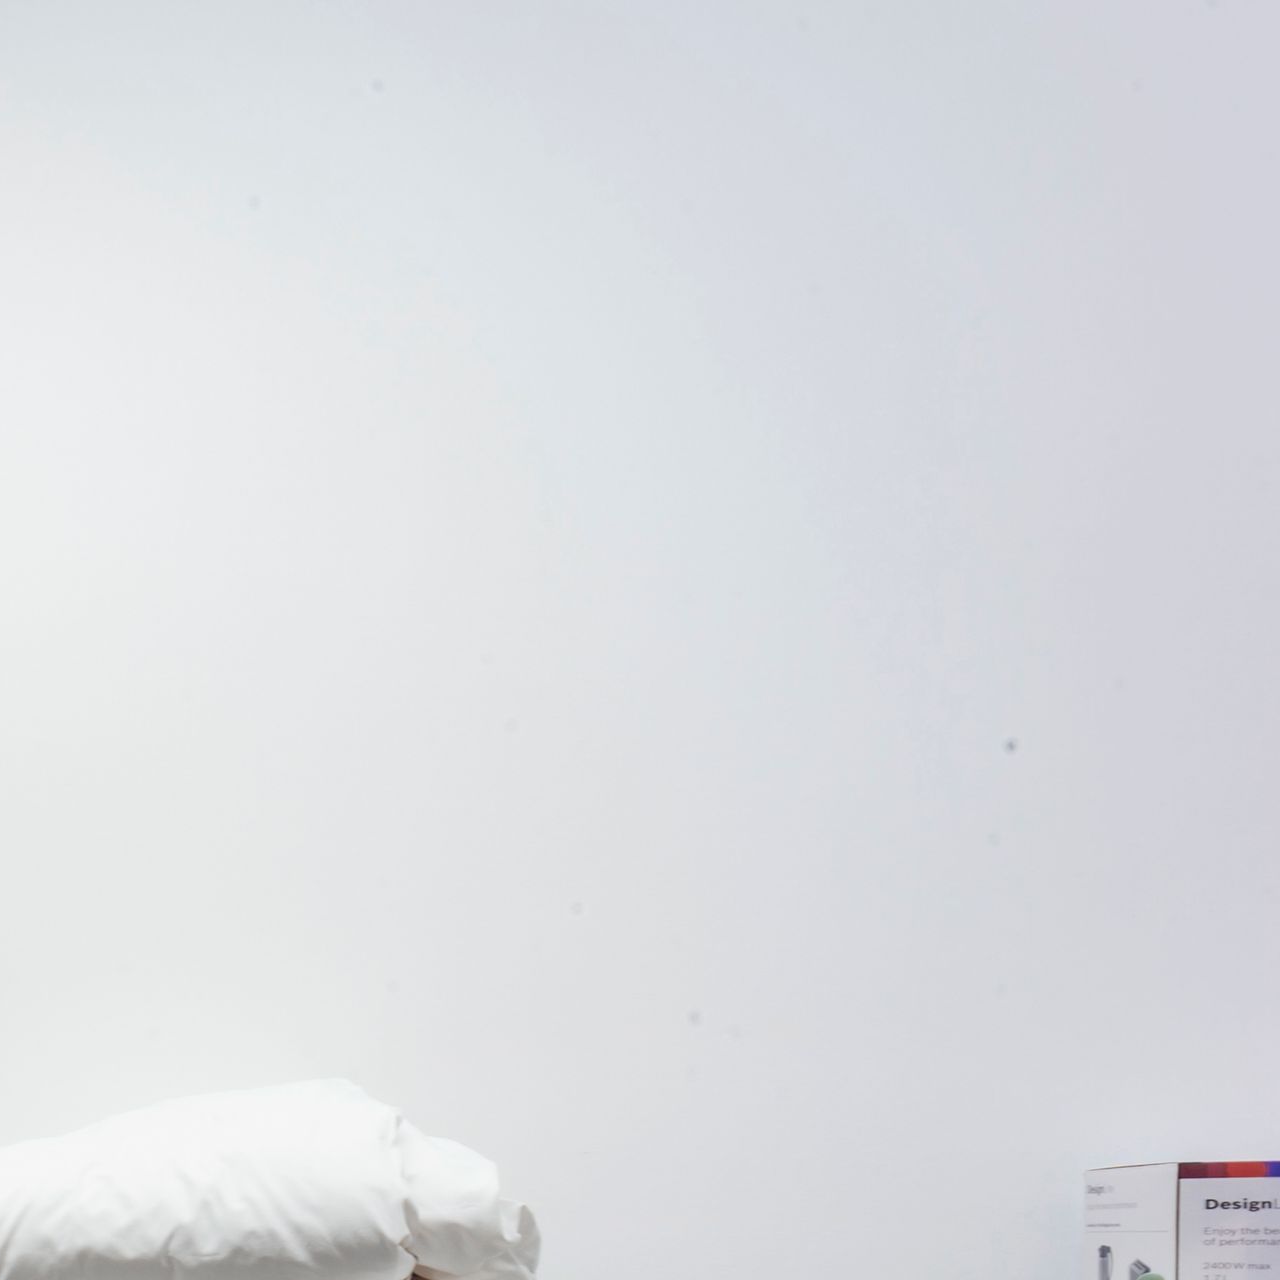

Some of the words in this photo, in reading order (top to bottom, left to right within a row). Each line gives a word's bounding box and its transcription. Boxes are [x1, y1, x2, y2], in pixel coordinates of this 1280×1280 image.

[1204, 1227, 1236, 1236] Enjoy
[1241, 1227, 1260, 1235] the
[1203, 1238, 1216, 1246] of
